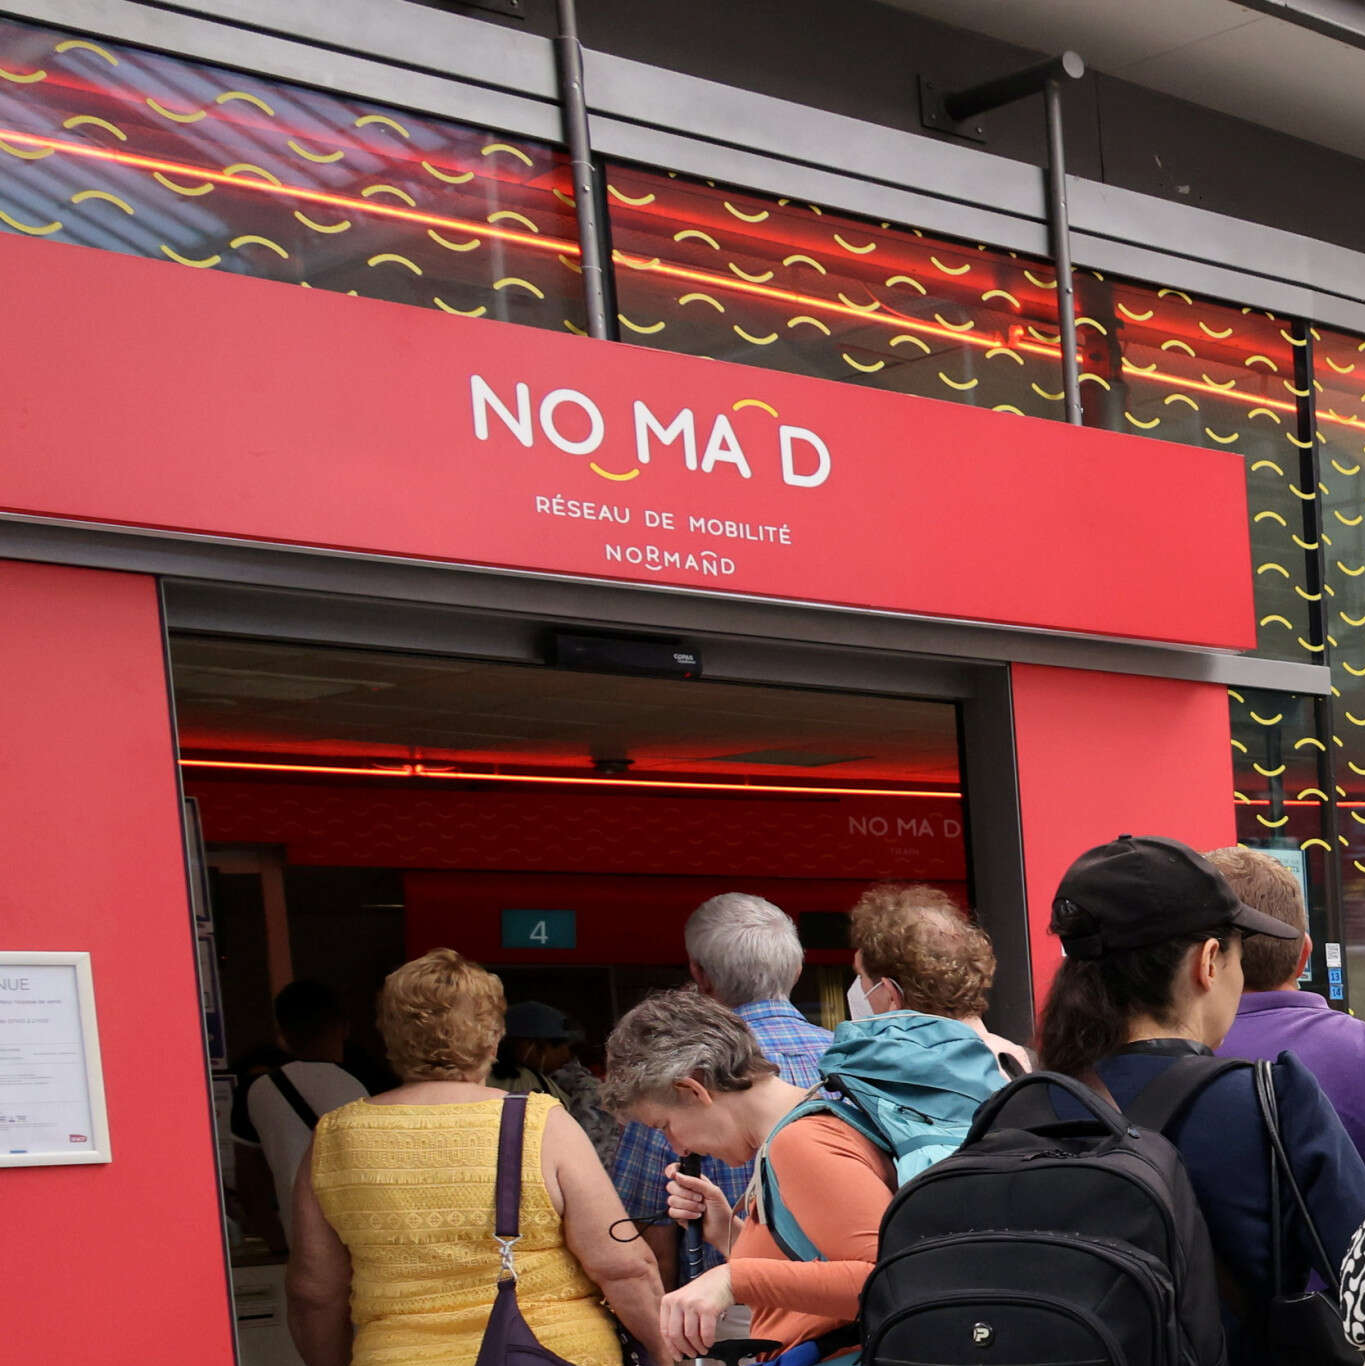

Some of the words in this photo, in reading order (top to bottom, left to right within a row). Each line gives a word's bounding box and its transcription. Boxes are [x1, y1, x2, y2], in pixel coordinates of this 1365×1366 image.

[535, 494, 631, 524] RÉSEAU
[644, 510, 675, 531] DE
[688, 515, 793, 545] MOBILITÉ
[604, 544, 736, 577] NORMAND
[529, 920, 549, 945] 4
